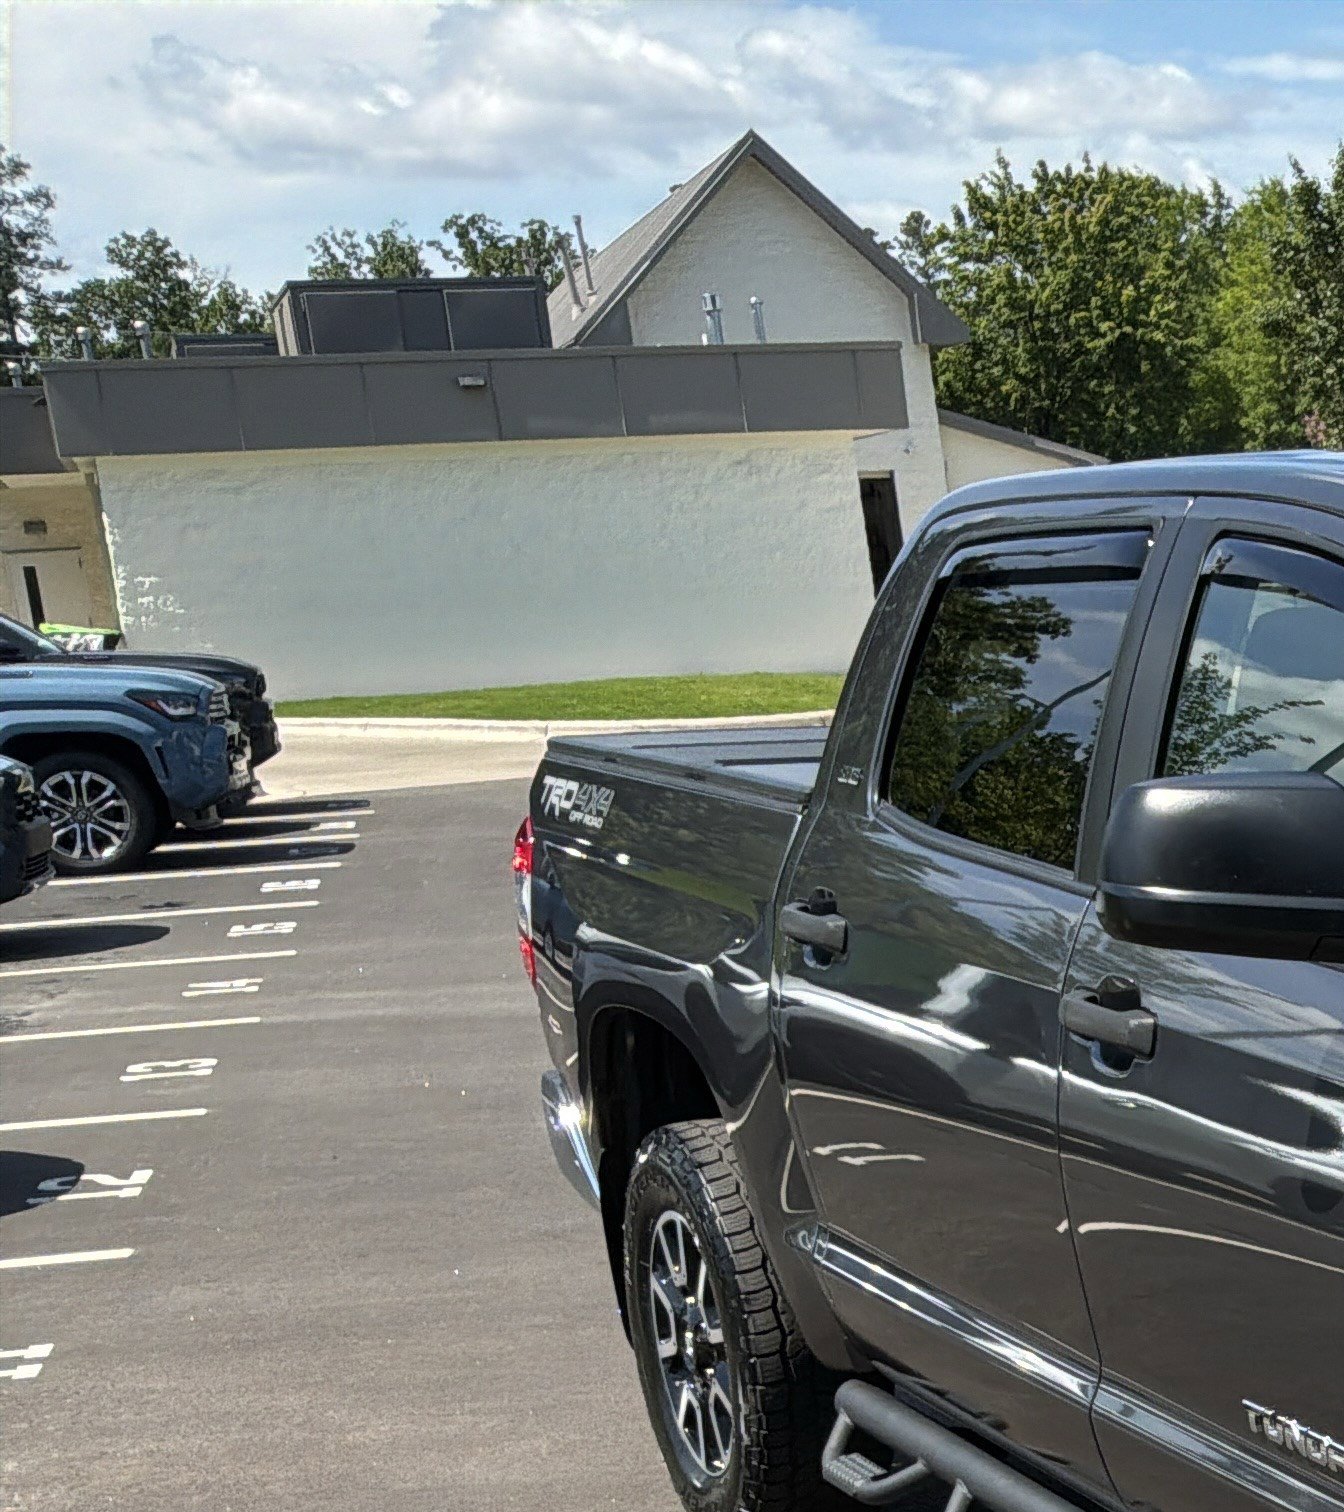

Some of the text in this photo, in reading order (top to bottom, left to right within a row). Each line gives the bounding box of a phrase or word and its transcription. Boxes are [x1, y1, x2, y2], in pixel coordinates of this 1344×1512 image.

[540, 774, 580, 819] TRD
[119, 1057, 219, 1083] 13
[26, 1169, 154, 1205] 12
